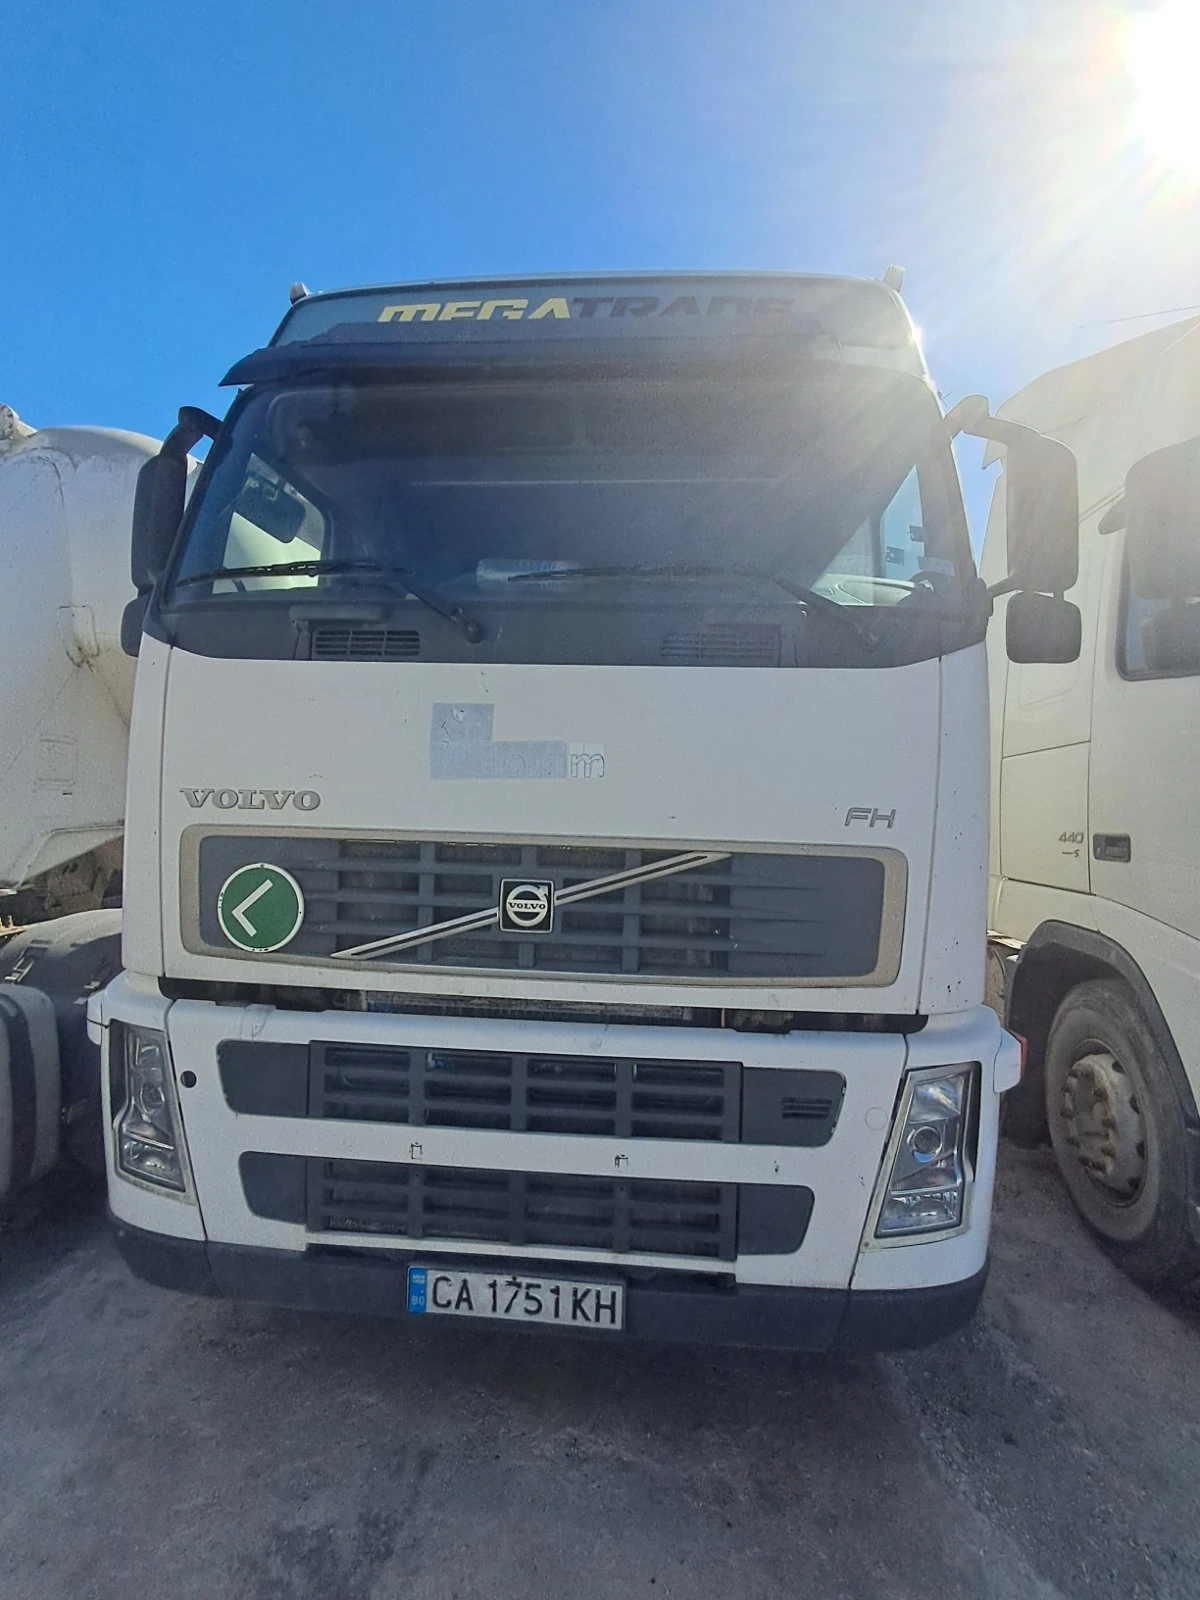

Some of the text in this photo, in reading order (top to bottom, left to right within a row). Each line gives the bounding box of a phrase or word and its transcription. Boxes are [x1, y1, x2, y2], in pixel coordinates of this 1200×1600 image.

[180, 788, 321, 811] VOLVO
[844, 807, 896, 829] FH
[1058, 831, 1084, 844] 440
[507, 901, 546, 910] VOLVO
